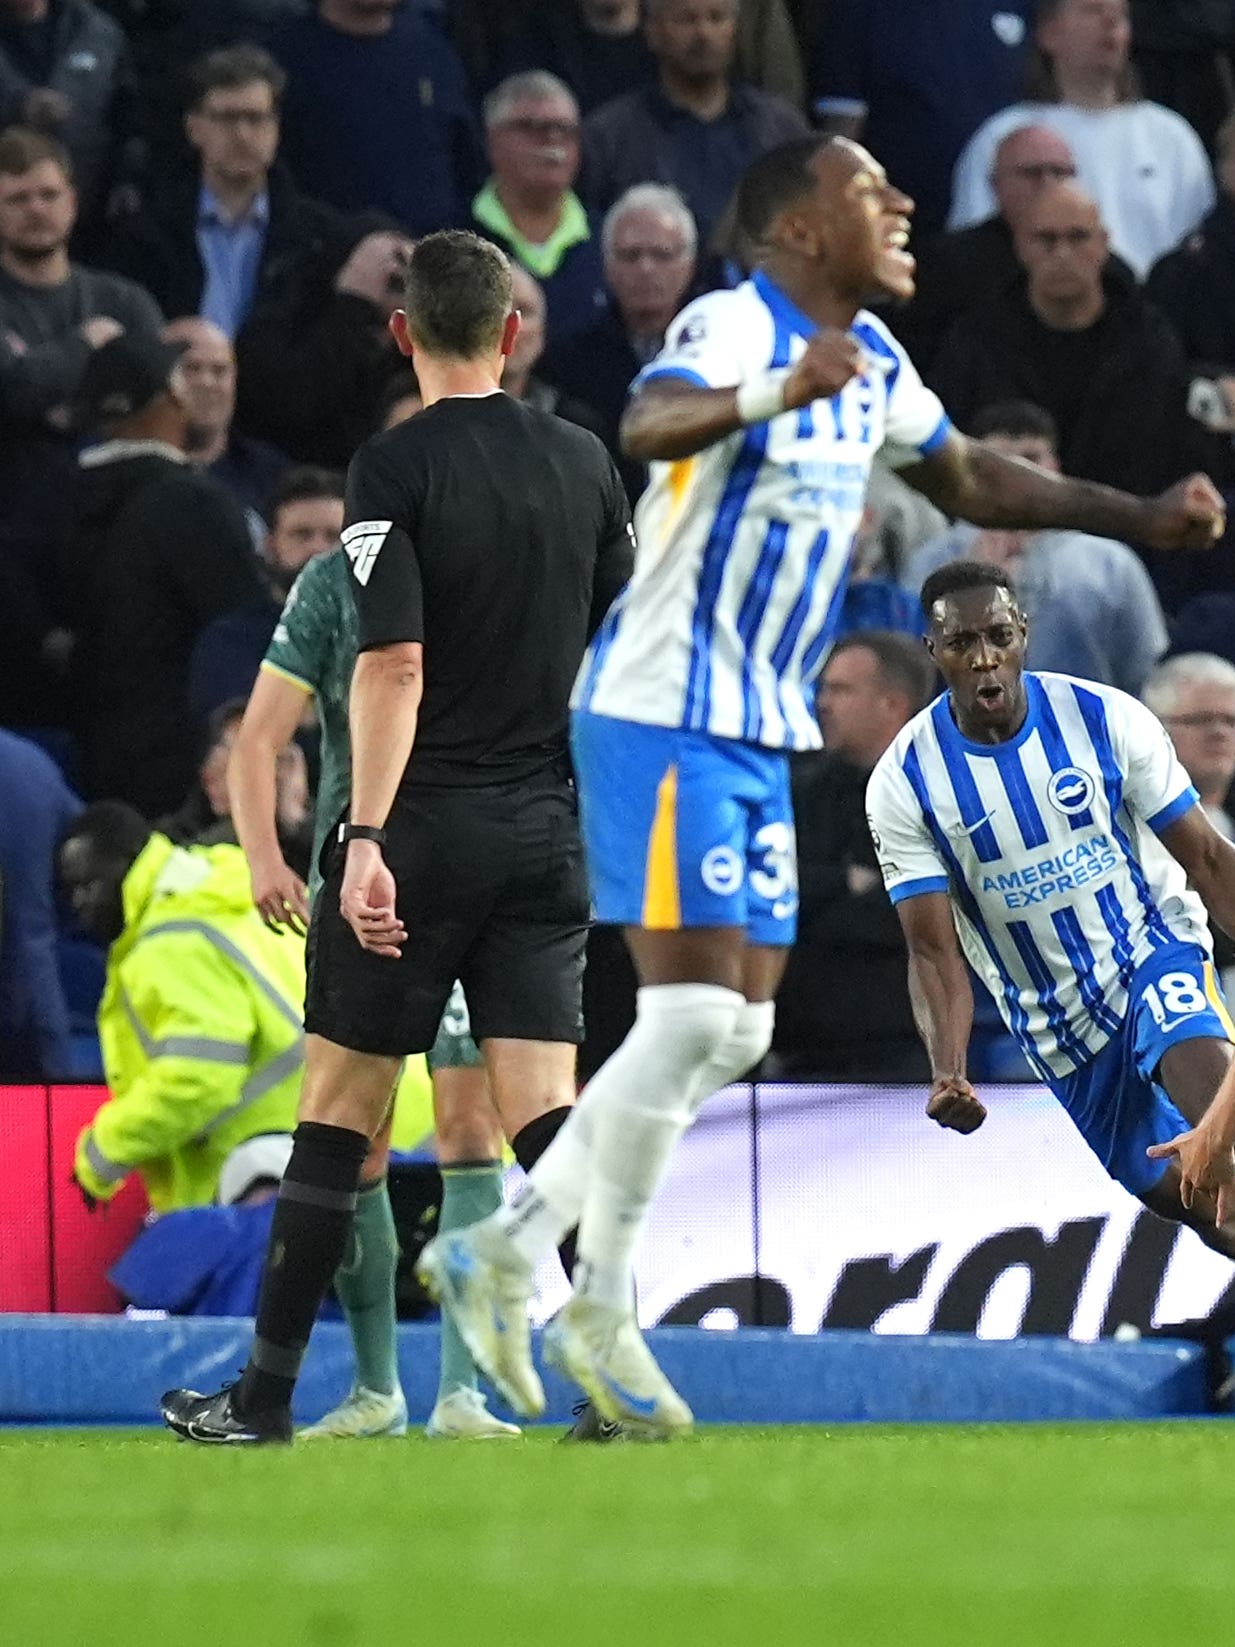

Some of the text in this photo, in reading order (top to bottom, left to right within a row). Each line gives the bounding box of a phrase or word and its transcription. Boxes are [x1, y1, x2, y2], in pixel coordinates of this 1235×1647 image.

[982, 834, 1110, 892] AMERICAN
[1003, 849, 1118, 910] EXPRESS
[1141, 971, 1207, 1025] 18
